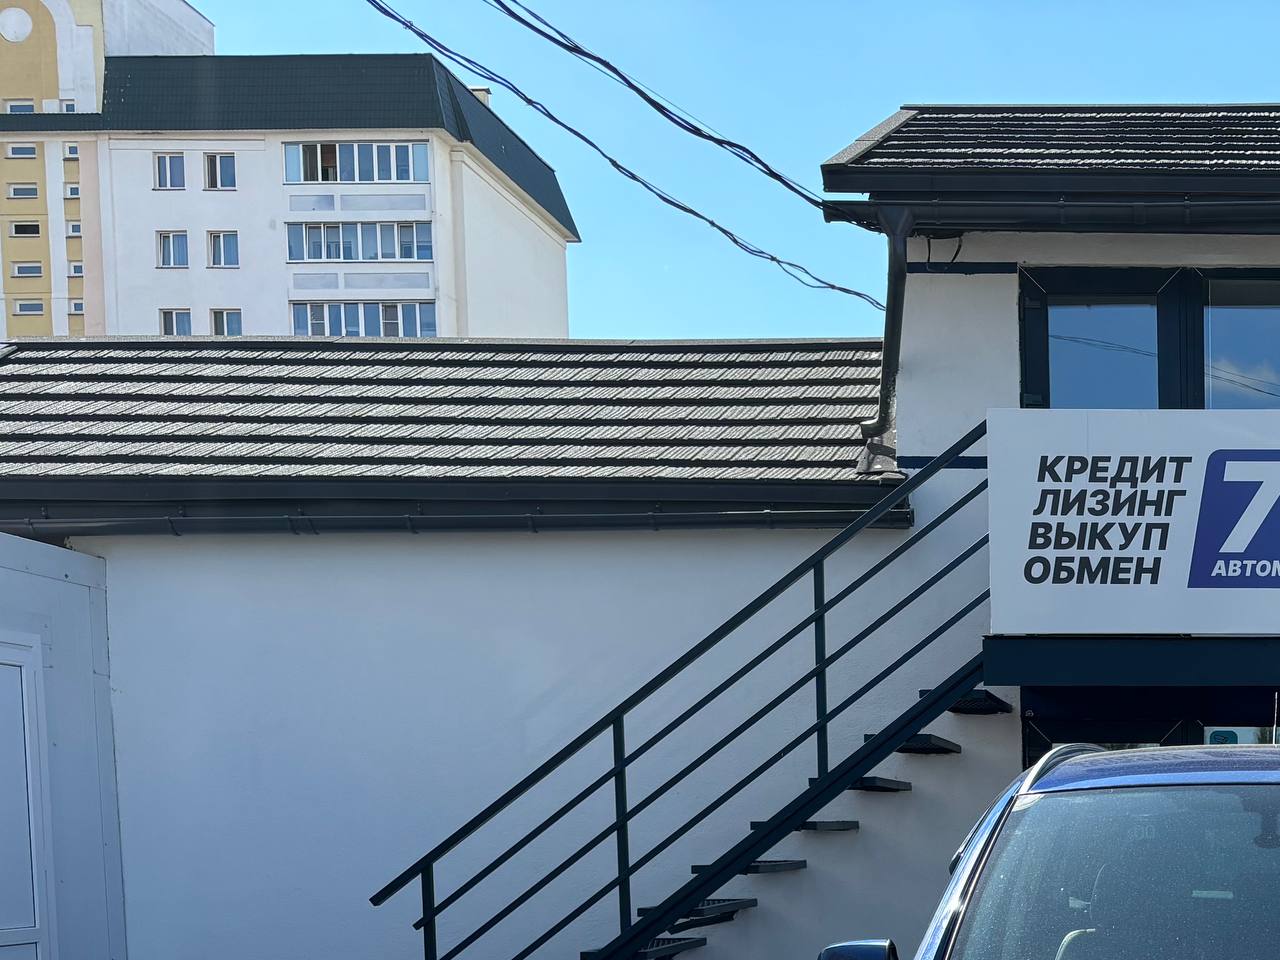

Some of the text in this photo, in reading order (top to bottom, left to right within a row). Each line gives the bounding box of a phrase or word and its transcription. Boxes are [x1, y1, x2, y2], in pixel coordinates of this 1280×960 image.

[1037, 455, 1192, 488] КРЕДИТ
[1032, 488, 1187, 517] ЛИЗИНГ
[1027, 521, 1170, 551] ВЫКУП
[1023, 555, 1162, 585] ОБМЕН
